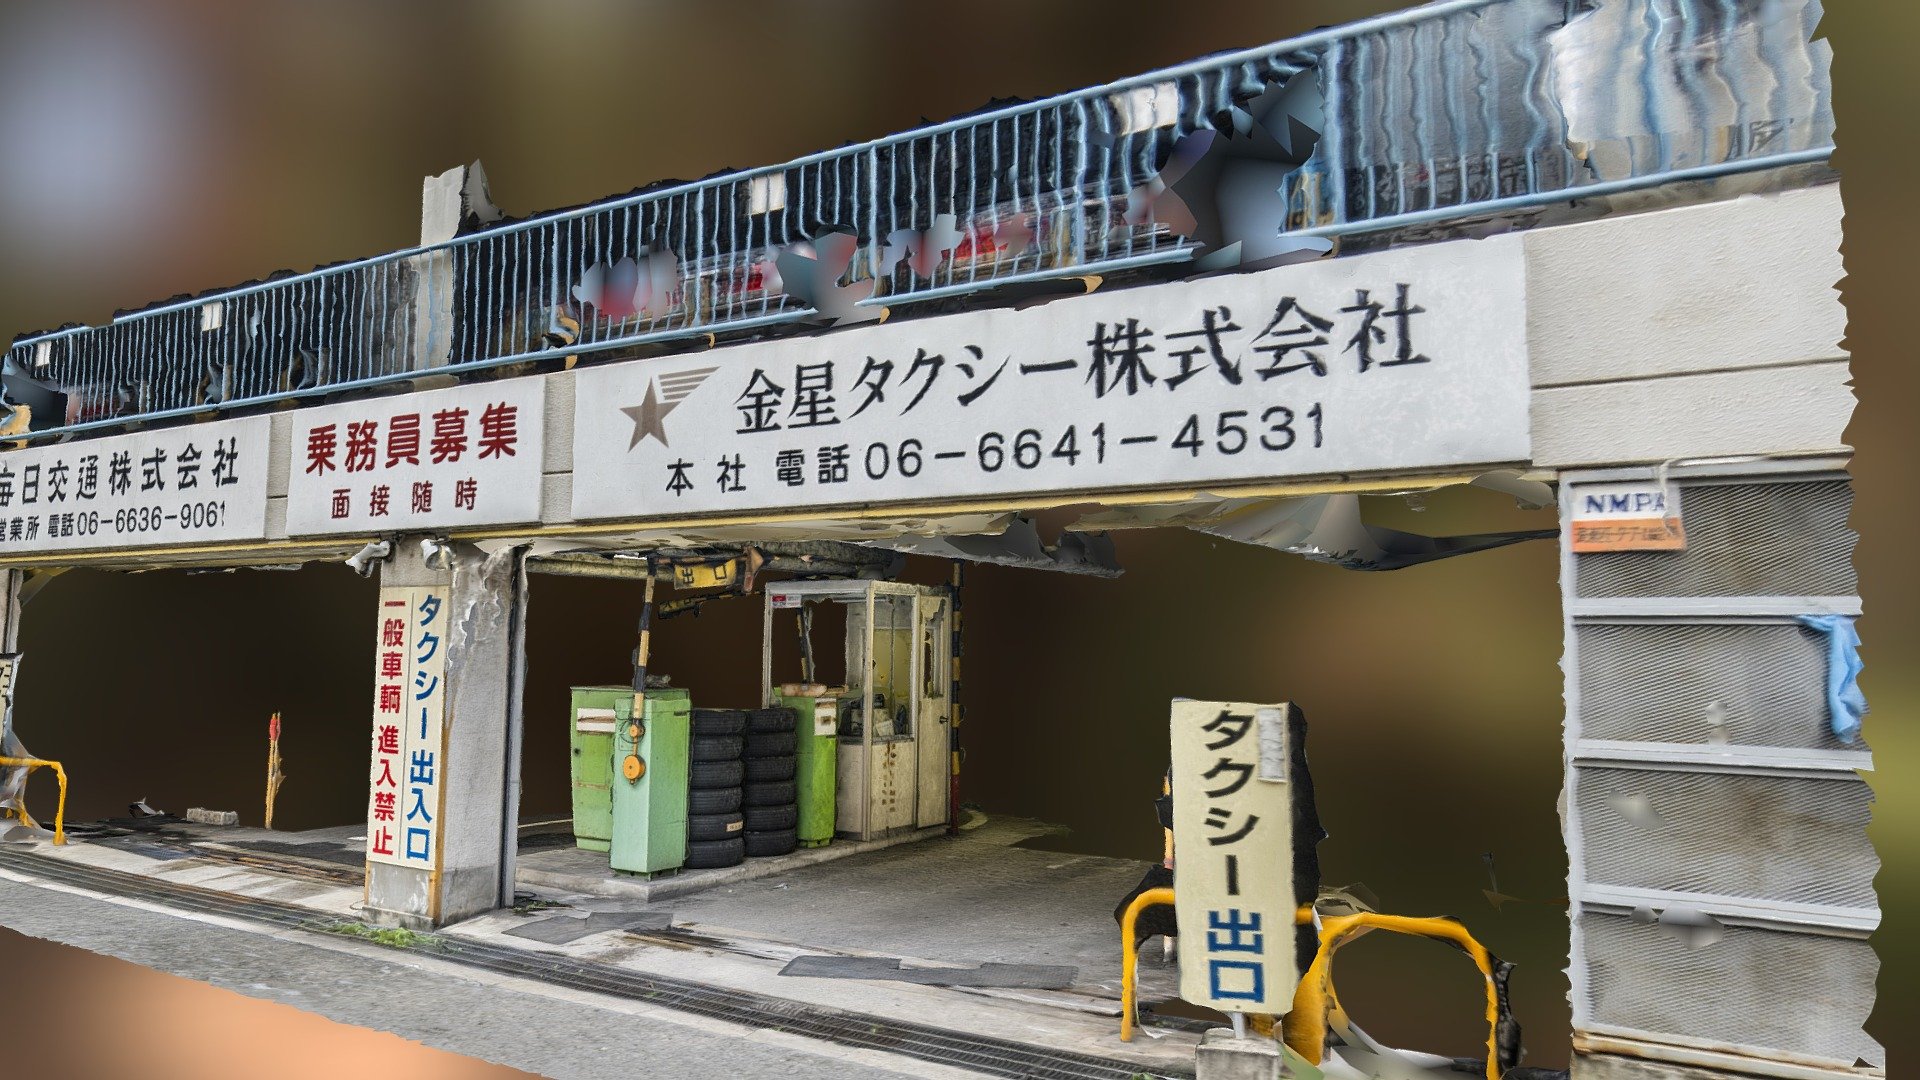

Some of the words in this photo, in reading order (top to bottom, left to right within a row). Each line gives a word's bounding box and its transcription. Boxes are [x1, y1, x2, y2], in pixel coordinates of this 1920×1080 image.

[734, 283, 1432, 436] 金星タクシー株式会社
[305, 401, 519, 477] 乗務員募集
[665, 452, 748, 498] 本社
[331, 476, 478, 520] 面接随時
[681, 563, 728, 584] 出口
[405, 593, 443, 862] タクシー出入口
[1200, 709, 1266, 1004] タクシー出口
